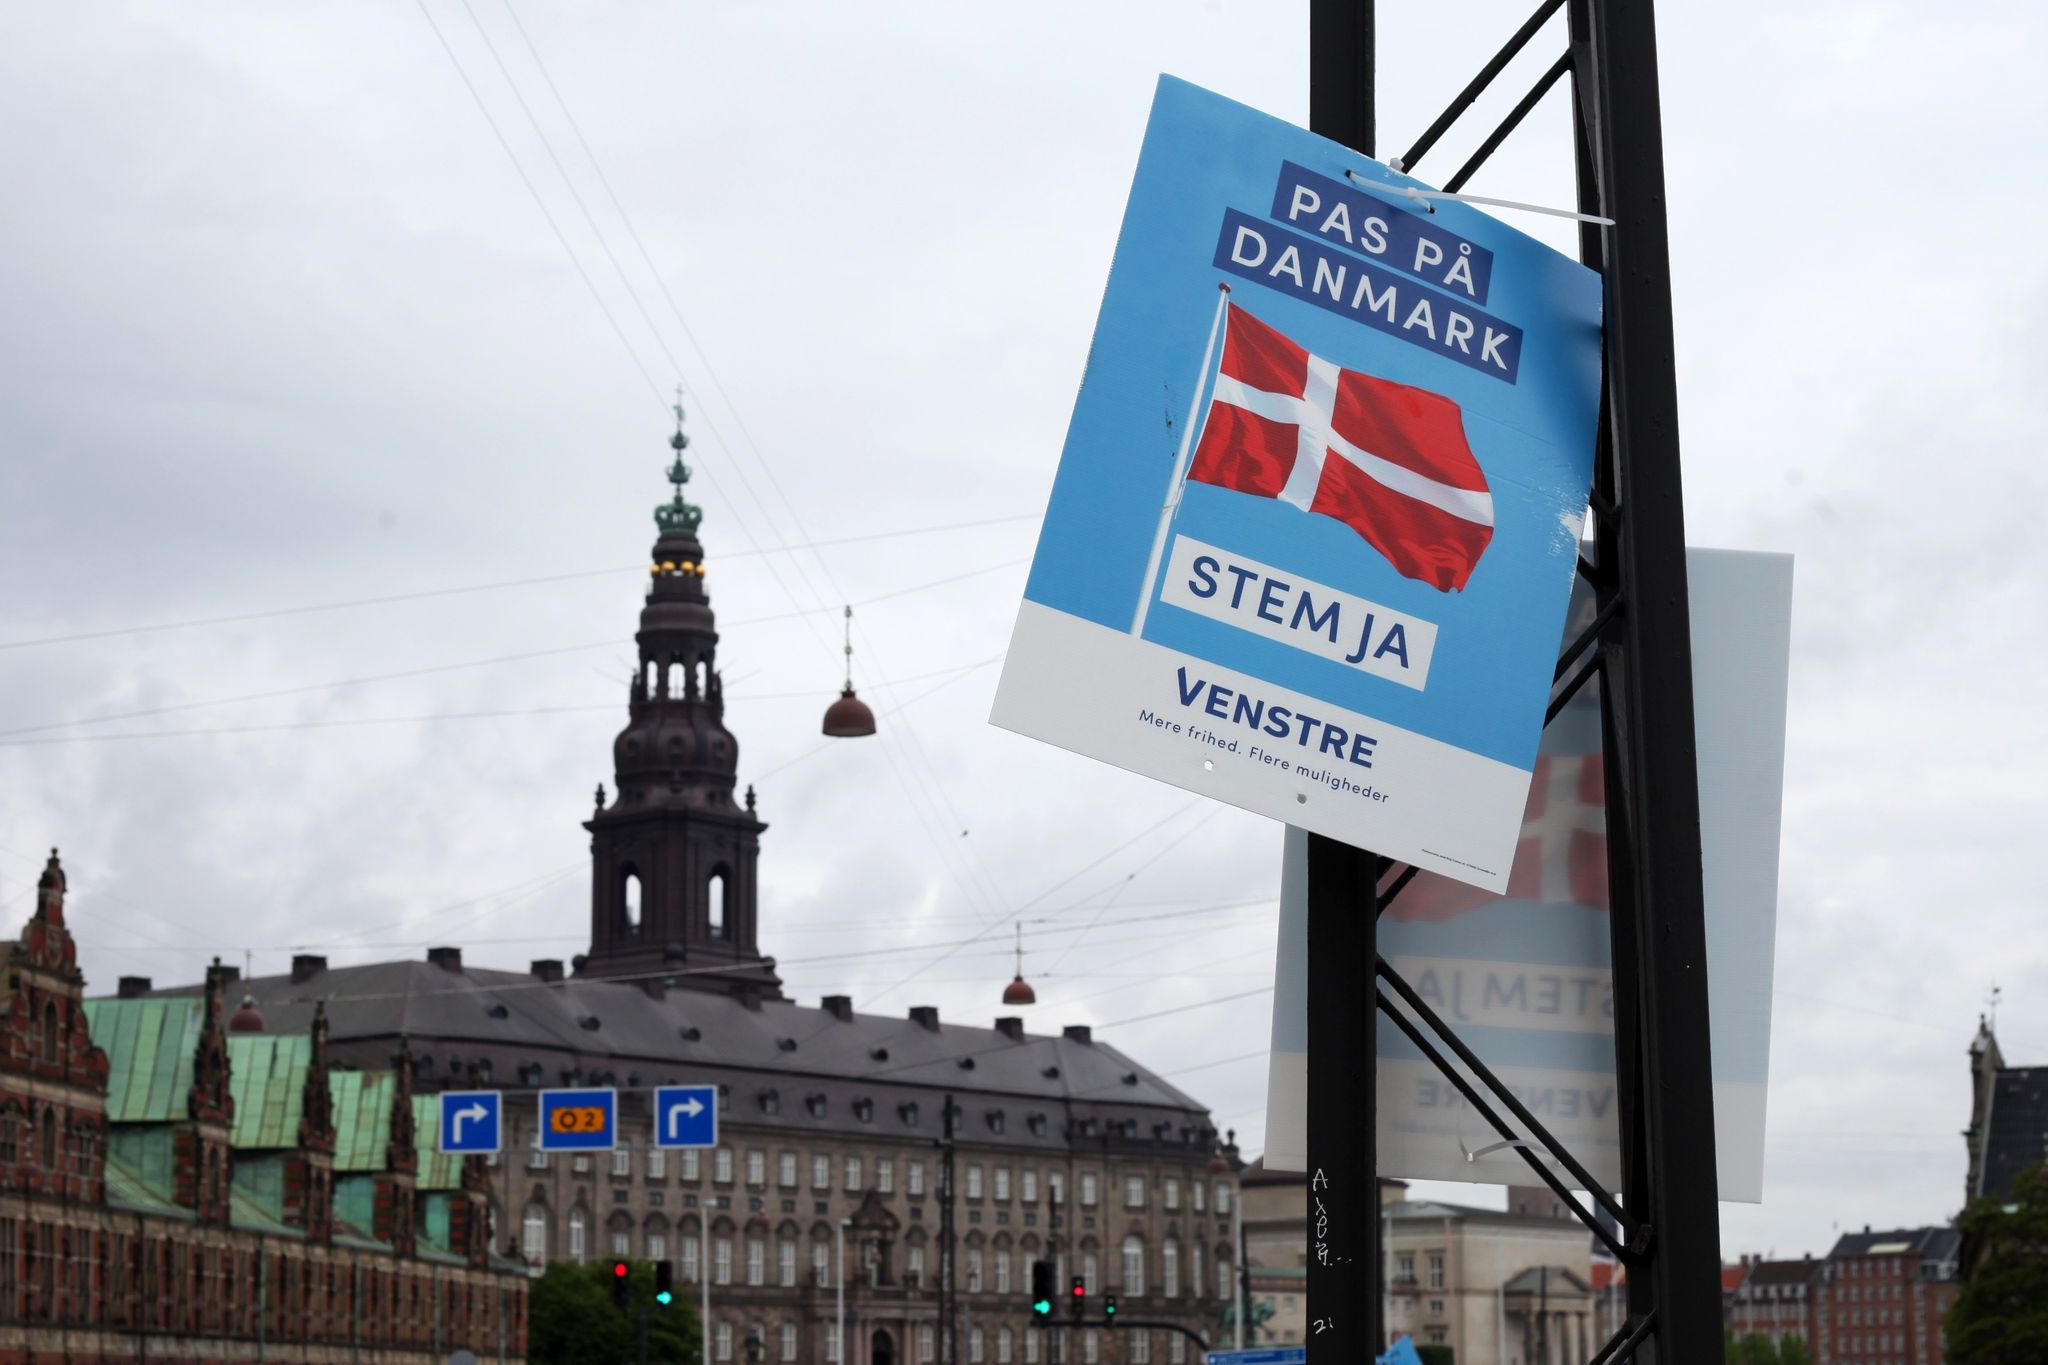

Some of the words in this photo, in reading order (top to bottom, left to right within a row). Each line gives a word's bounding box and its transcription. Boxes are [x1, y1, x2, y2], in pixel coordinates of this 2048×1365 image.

[1288, 184, 1389, 255] PAS
[1413, 236, 1476, 297] PÅ
[1230, 225, 1509, 371] DANMARK
[1187, 555, 1341, 644] STEM
[1344, 613, 1410, 669] JA
[1138, 708, 1182, 734] Mere
[1187, 725, 1242, 755] frihed.
[1249, 746, 1290, 771] Flere
[1295, 763, 1390, 804] muligheder
[1176, 666, 1378, 769] VENSTRE
